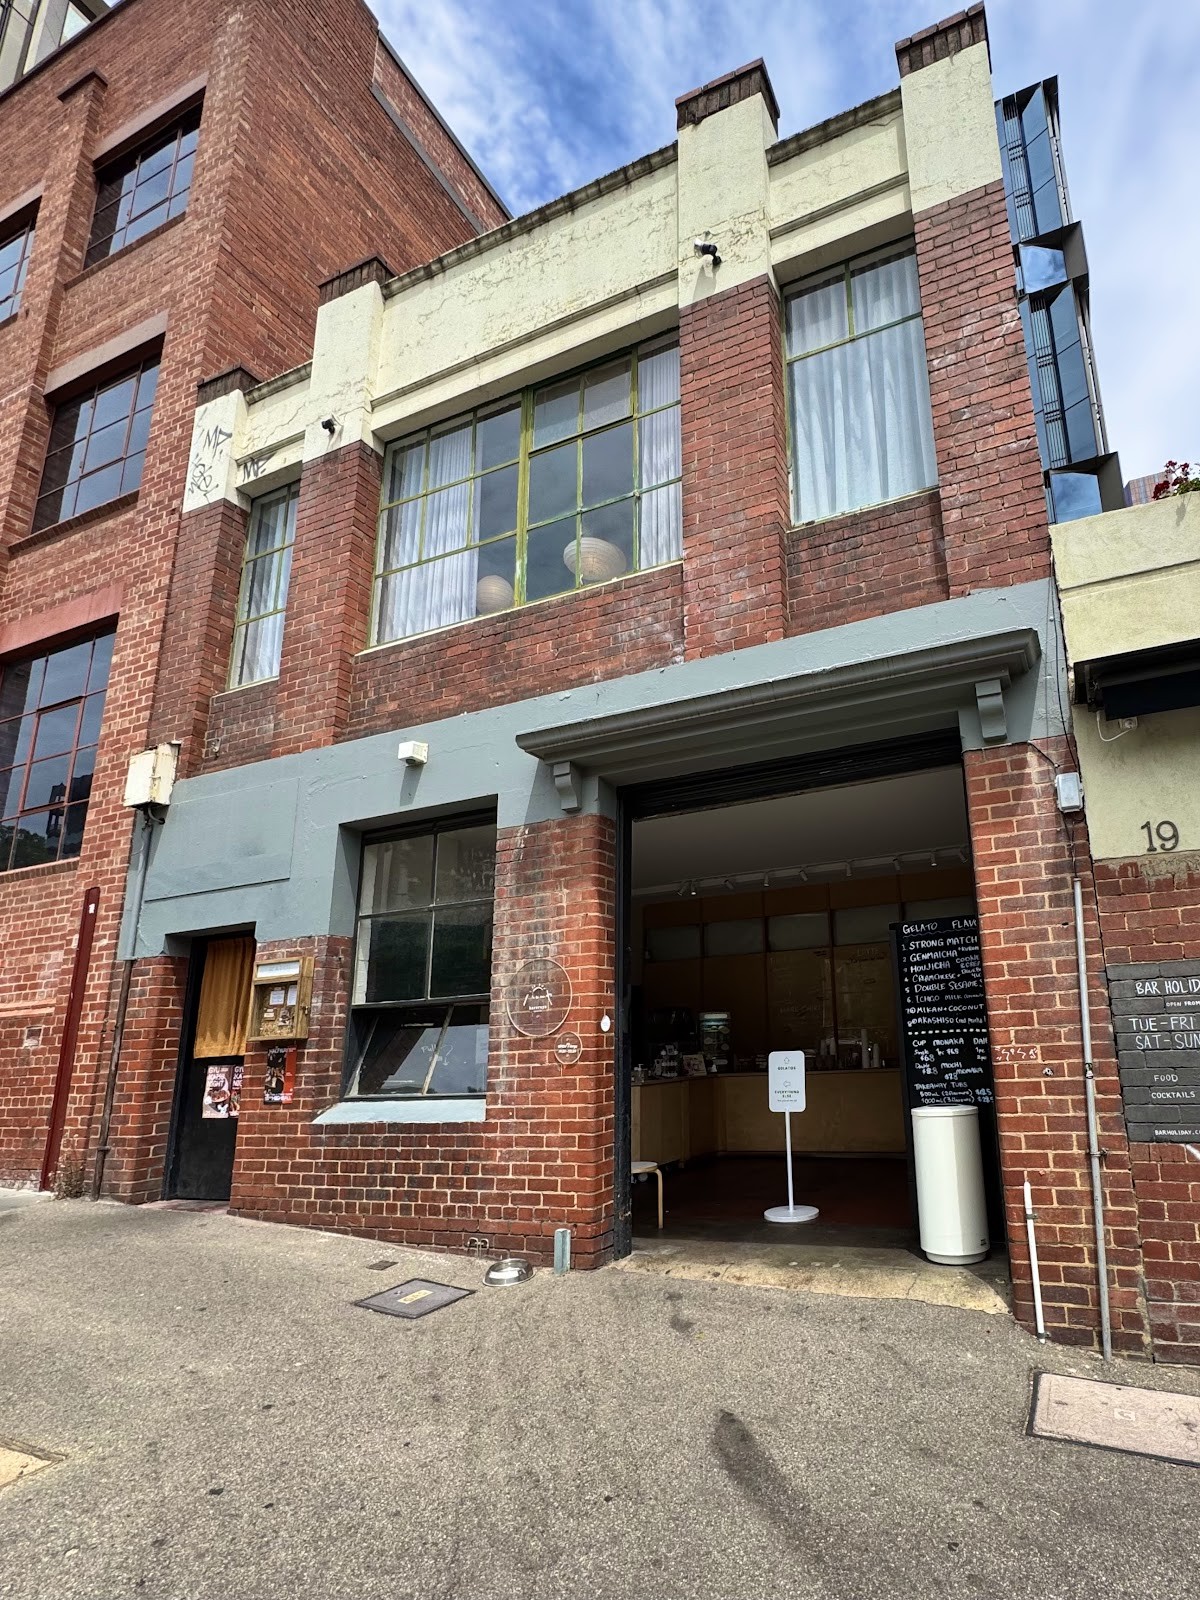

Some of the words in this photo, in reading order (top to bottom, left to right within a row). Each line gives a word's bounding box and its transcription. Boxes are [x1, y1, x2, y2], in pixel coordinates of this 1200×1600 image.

[1141, 820, 1179, 852] 19
[902, 922, 938, 934] GELATO
[909, 938, 944, 950] STRONG
[910, 950, 958, 962] GENMAICHA
[910, 961, 951, 973] HOUJICHA
[914, 983, 946, 993] DOUBLE
[1136, 981, 1161, 995] BAR
[912, 1039, 927, 1047] CUP
[1154, 1074, 1179, 1082] FOOD
[1151, 1091, 1195, 1099] COCKTAILS
